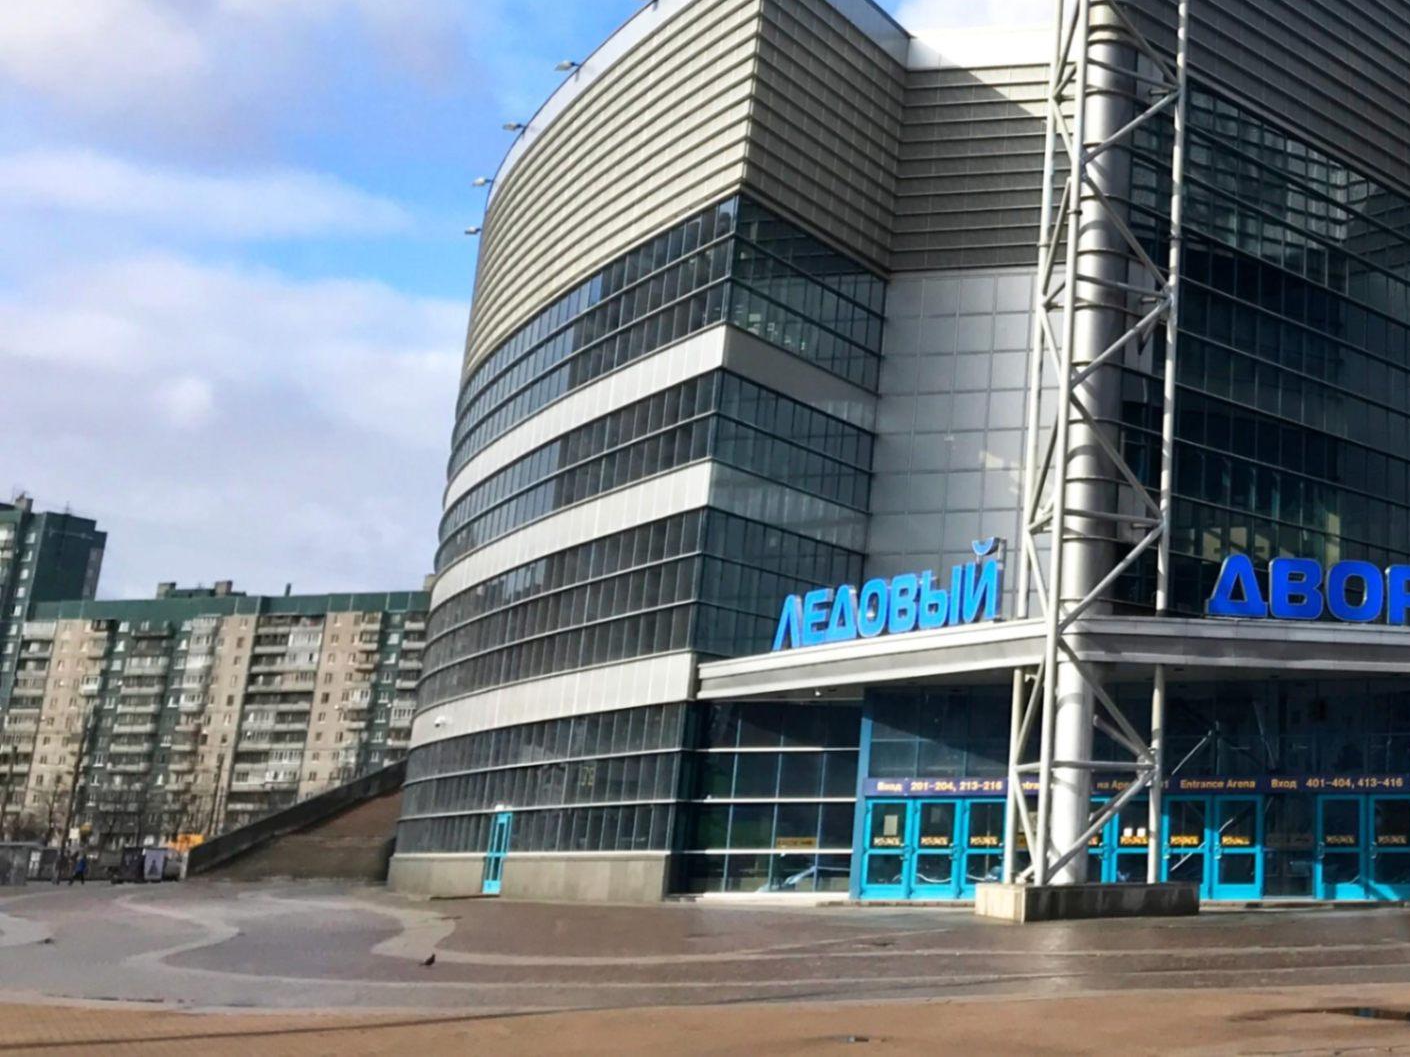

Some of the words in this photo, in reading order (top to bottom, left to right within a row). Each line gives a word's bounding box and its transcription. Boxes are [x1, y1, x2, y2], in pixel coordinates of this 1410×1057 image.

[772, 537, 1003, 651] ЛЕДОВЫЙ
[1180, 779, 1224, 789] Entrance
[1226, 779, 1256, 789] Arena
[1271, 778, 1297, 789] Вход
